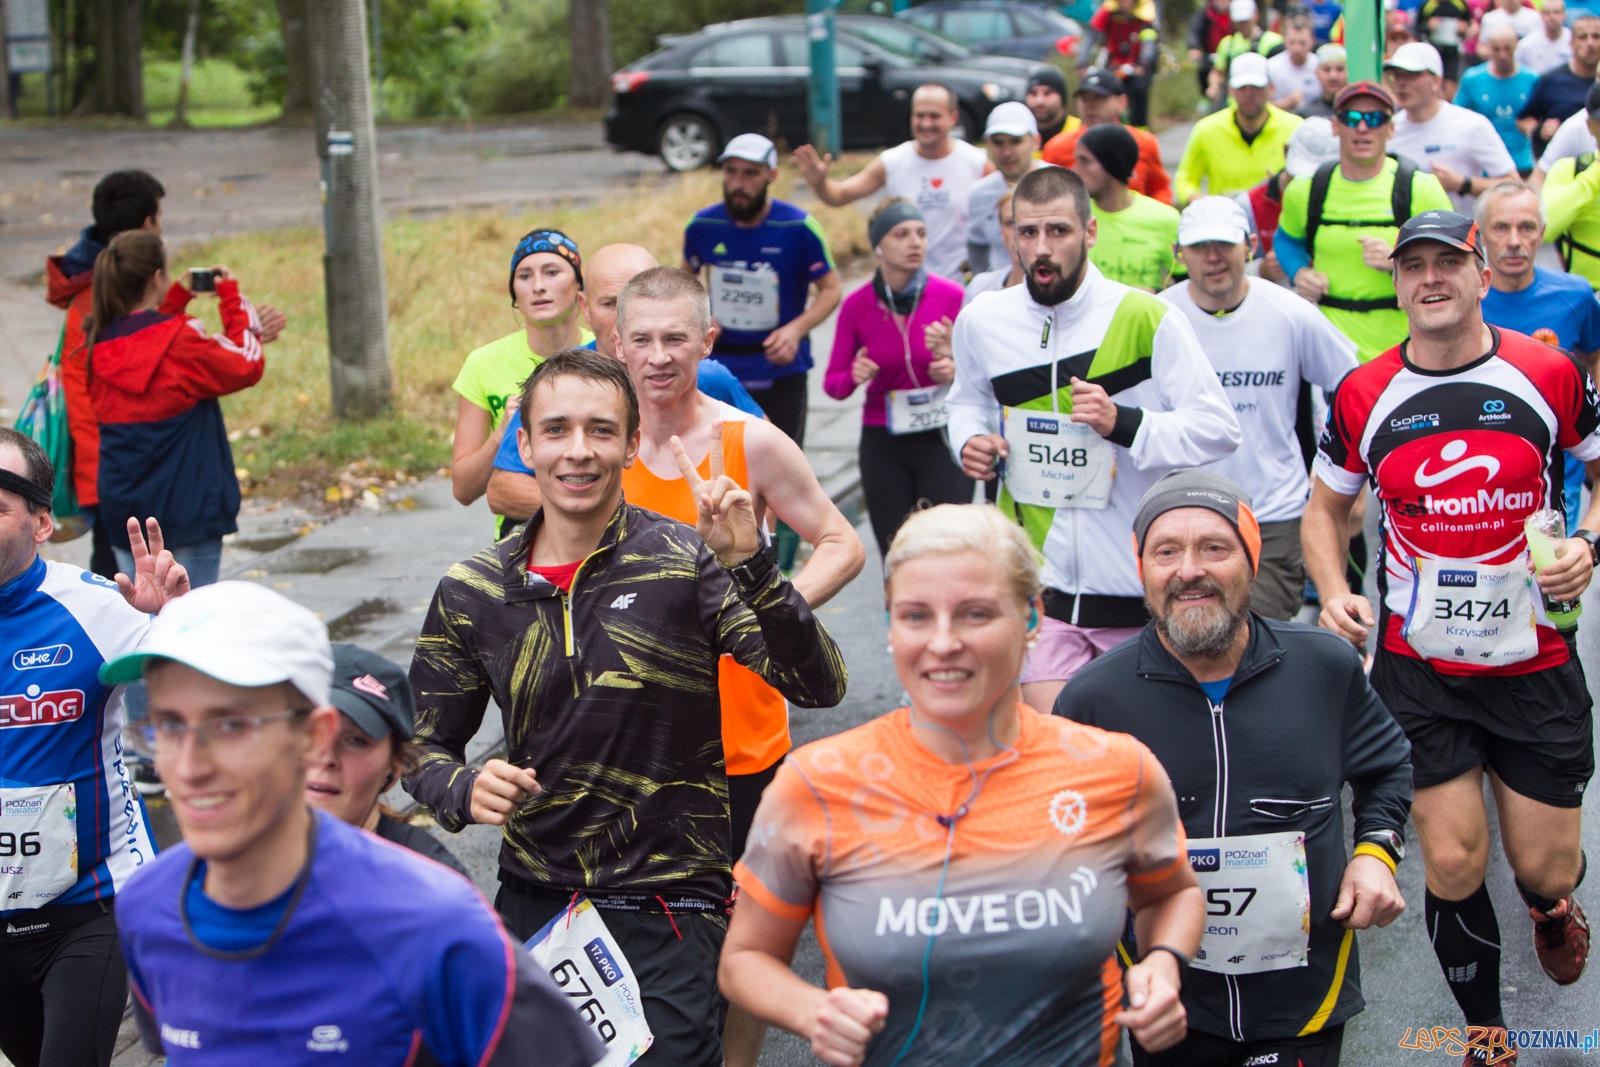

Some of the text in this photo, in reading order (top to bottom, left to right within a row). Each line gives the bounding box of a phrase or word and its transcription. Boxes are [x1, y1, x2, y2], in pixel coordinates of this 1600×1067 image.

[721, 288, 764, 304] 2299
[1390, 413, 1440, 428] GoPro
[1479, 413, 1512, 421] ArtMedia
[1029, 444, 1088, 467] 5148
[610, 592, 638, 610] 4F
[1435, 598, 1511, 622] 3474
[1446, 625, 1499, 638] Krzysztof
[20, 652, 51, 666] bike
[5, 806, 42, 815] maraton
[1225, 858, 1268, 867] maraton
[1227, 955, 1246, 964] 4F
